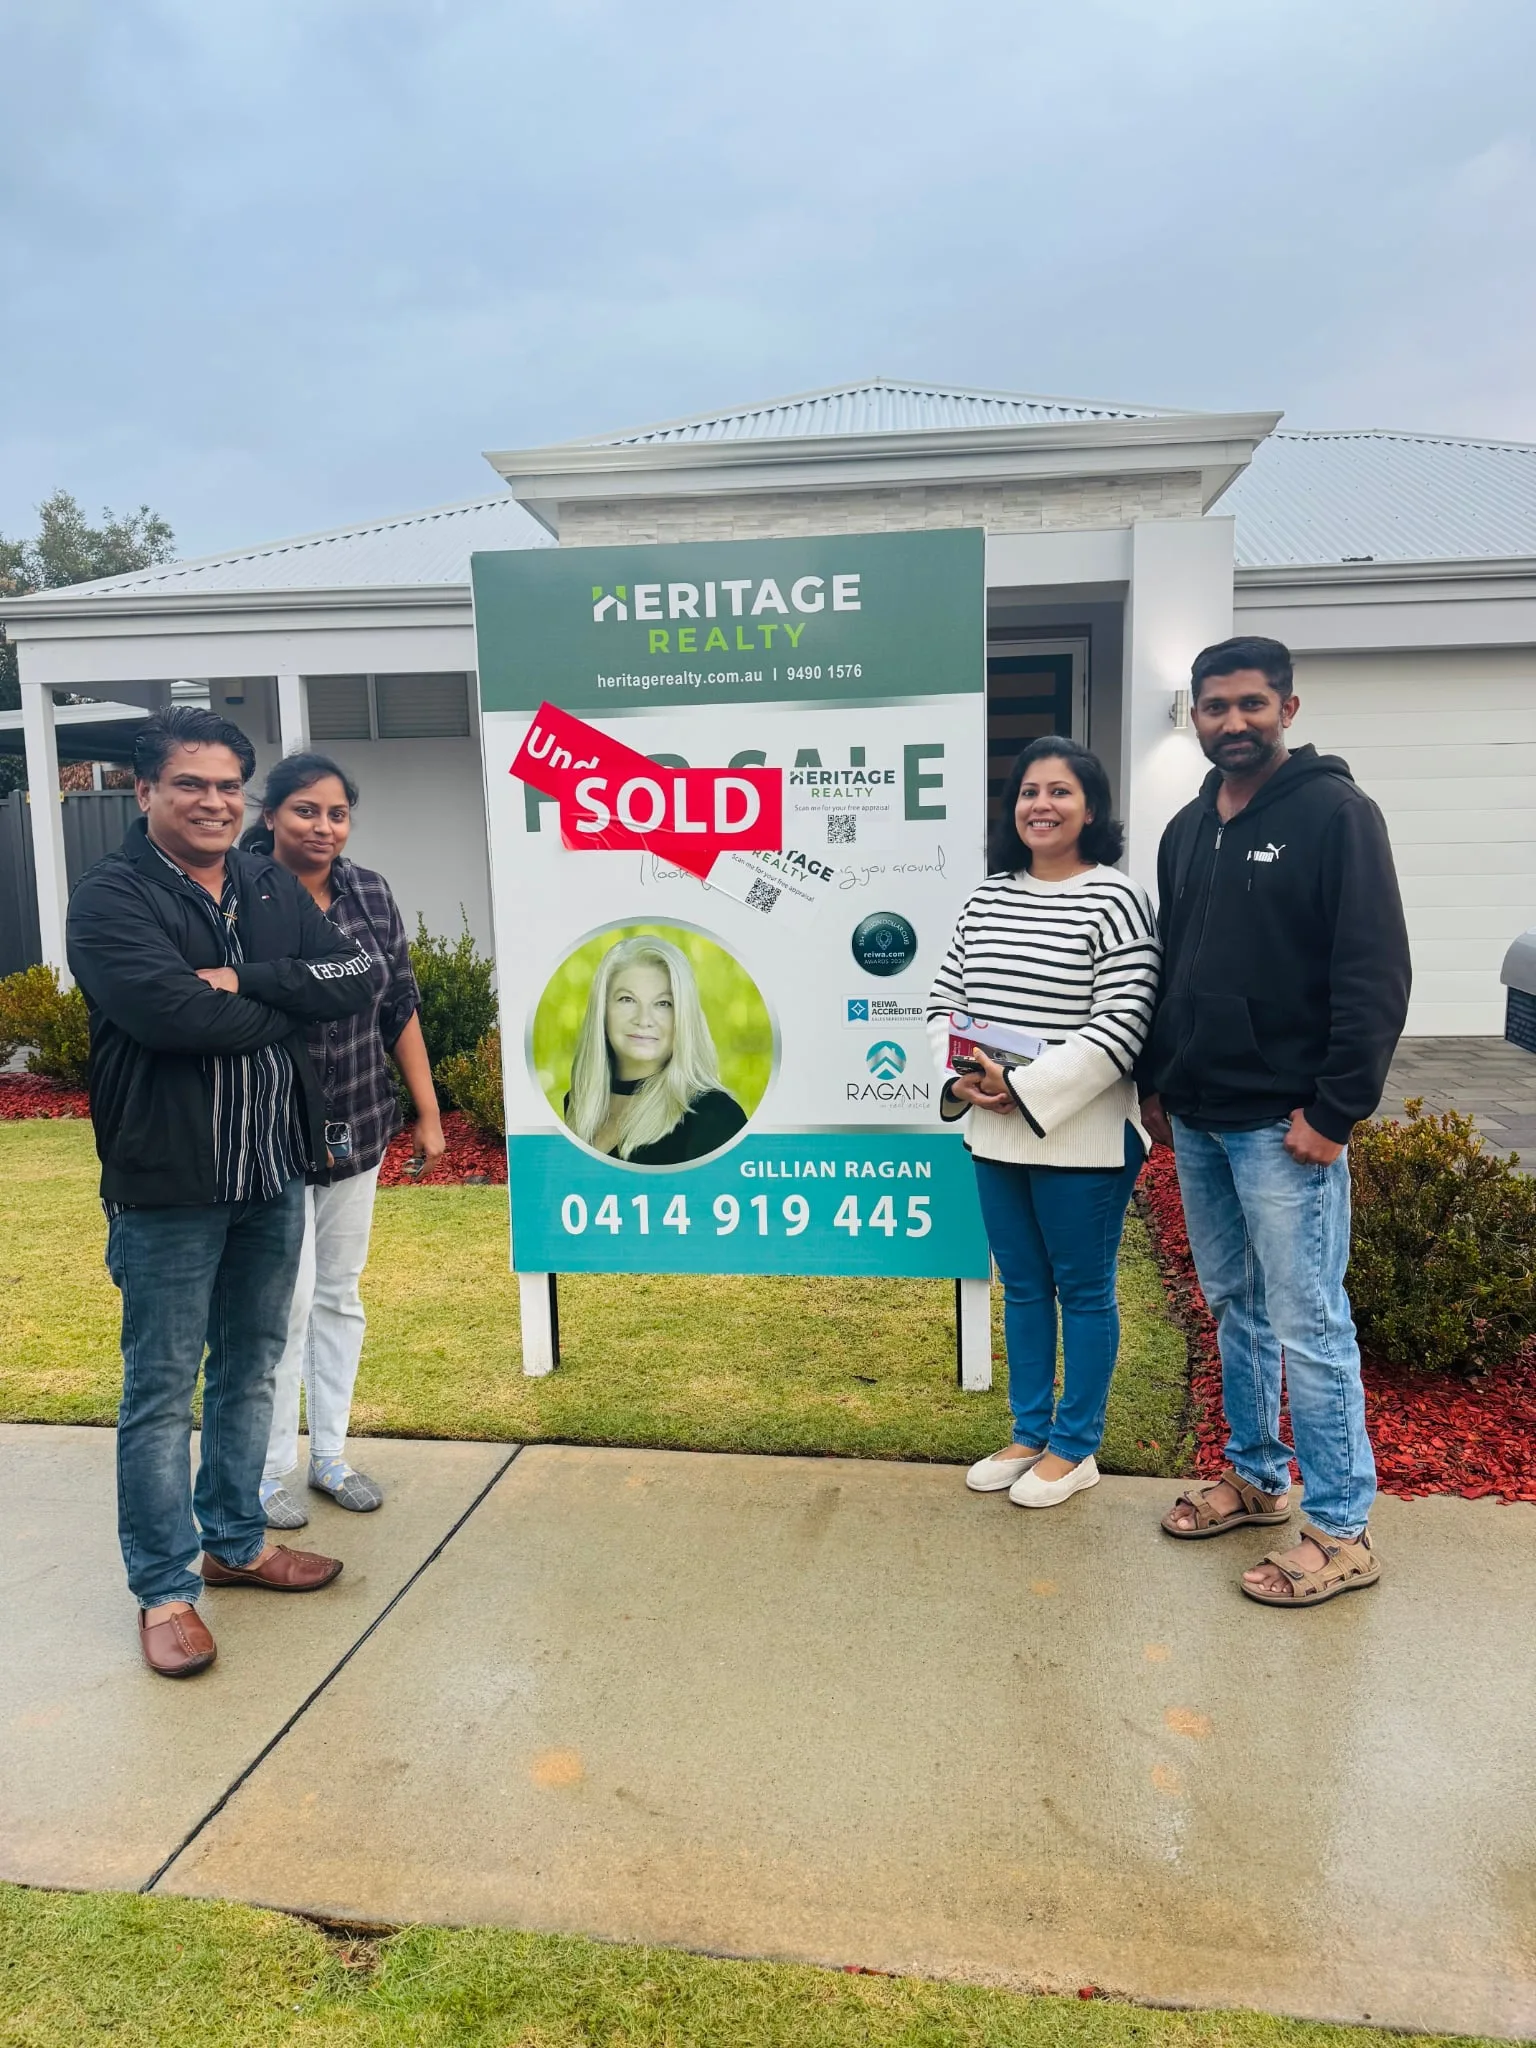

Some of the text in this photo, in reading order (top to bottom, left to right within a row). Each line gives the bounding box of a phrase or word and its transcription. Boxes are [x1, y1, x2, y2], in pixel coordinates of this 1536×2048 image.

[592, 574, 862, 623] HERITAGE
[648, 622, 806, 655] REALTY
[597, 670, 763, 690] heritagerealty.com.au
[786, 666, 822, 681] 9490
[827, 663, 862, 679] 1576
[789, 770, 896, 785] HERITAGE
[811, 787, 873, 798] REALTY
[575, 776, 761, 834] SOLD
[794, 804, 810, 812] Scan
[832, 805, 846, 813] your
[862, 804, 890, 812] appraisal
[778, 850, 835, 883] TAGE
[860, 865, 886, 887] you
[892, 844, 947, 880] around
[731, 853, 746, 866] Scan
[788, 886, 815, 903] appraisal
[863, 950, 905, 958] reiwa.com
[871, 1000, 898, 1008] REIWA
[871, 1007, 923, 1016] ACCREDITED
[847, 1082, 929, 1101] RAGAN
[740, 1160, 932, 1179] GILLIAN RAGAN
[561, 1193, 932, 1238] 0414 919 445
